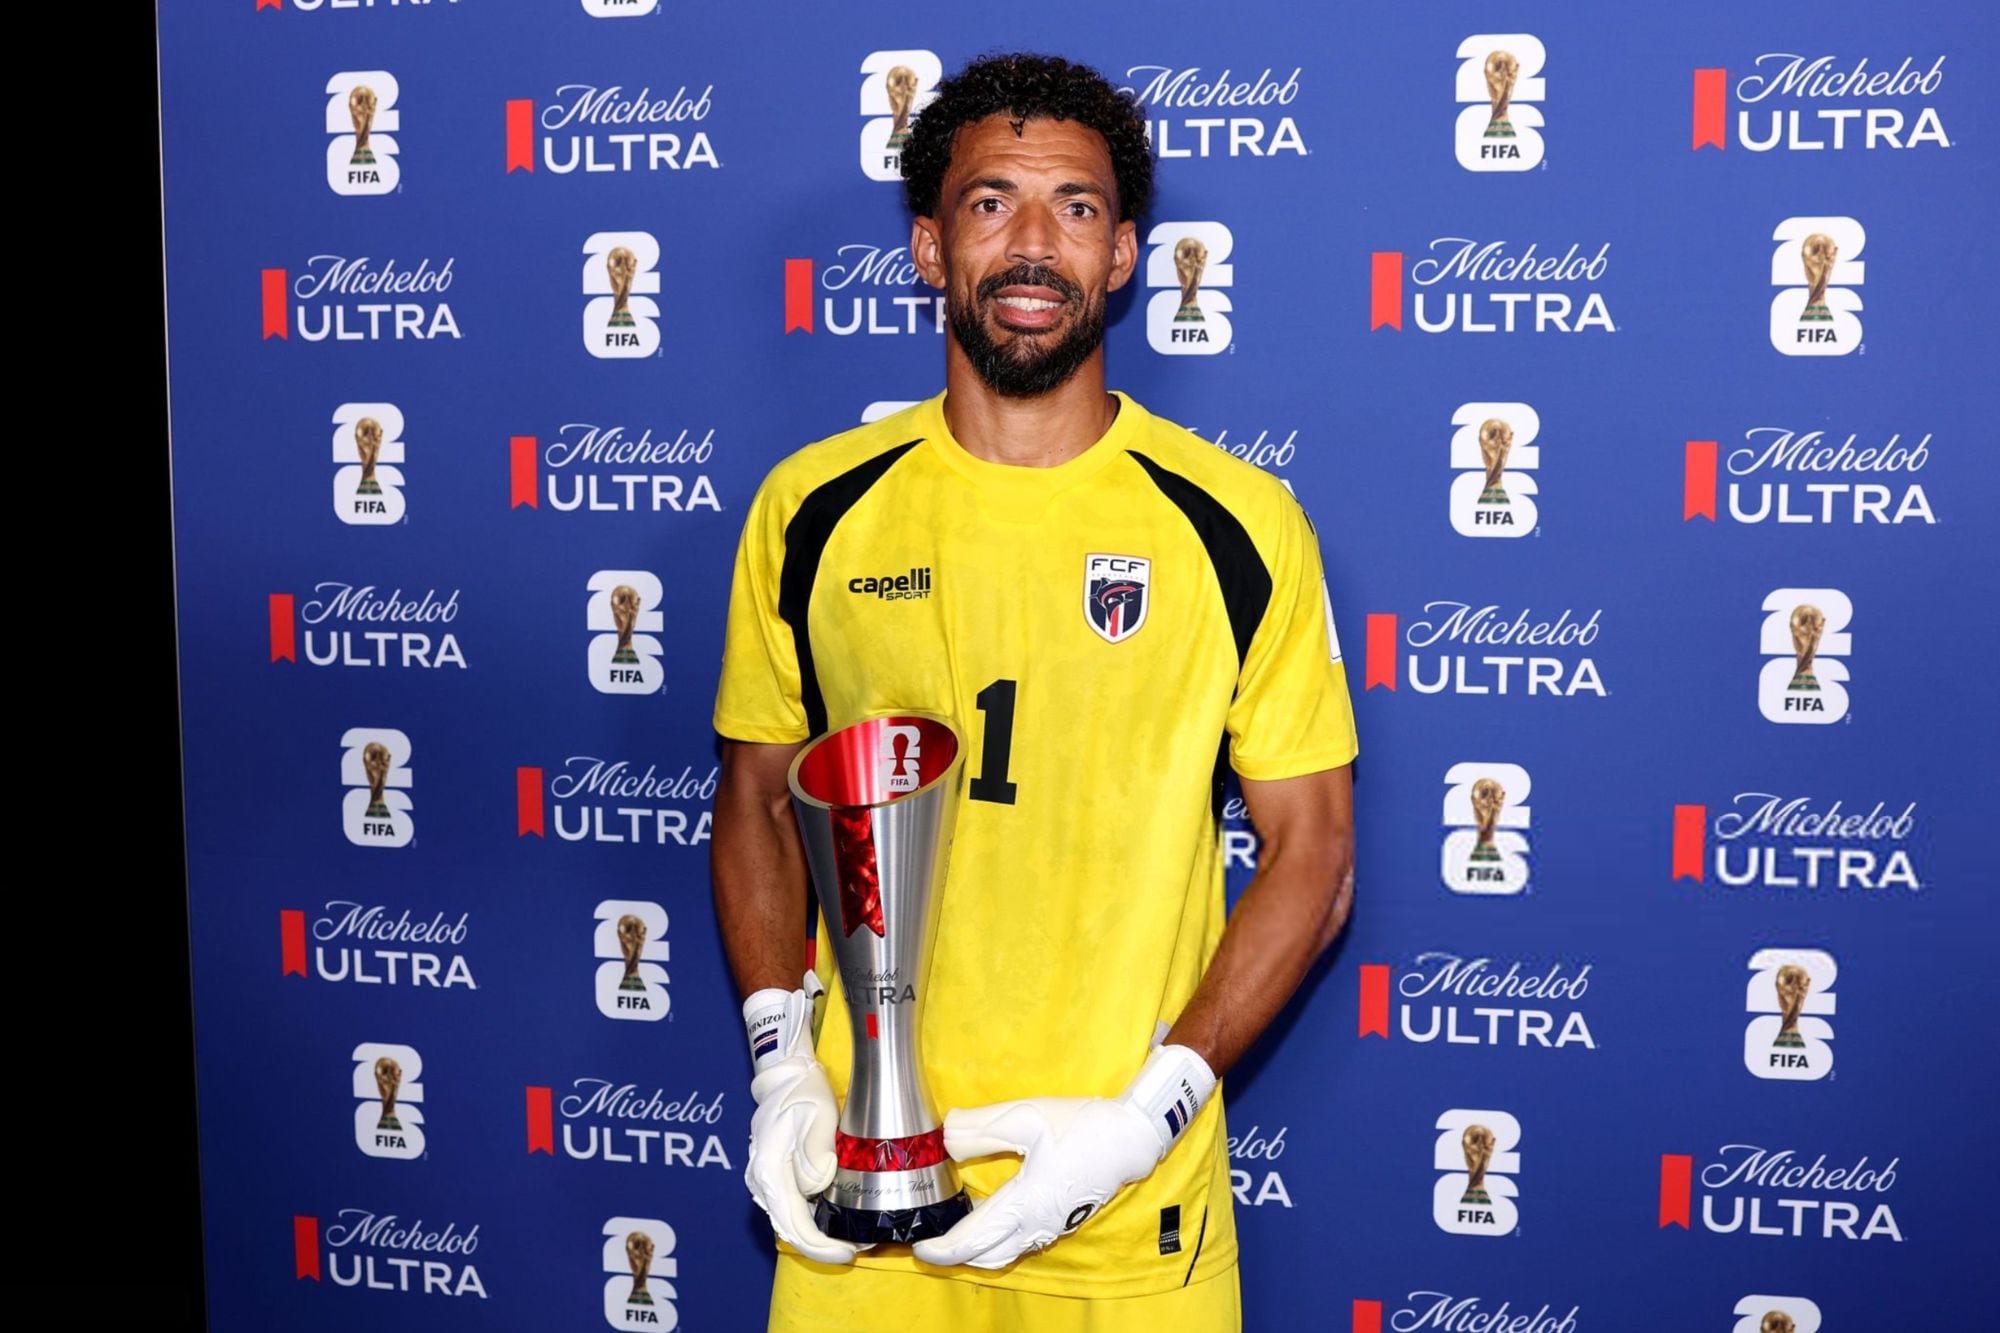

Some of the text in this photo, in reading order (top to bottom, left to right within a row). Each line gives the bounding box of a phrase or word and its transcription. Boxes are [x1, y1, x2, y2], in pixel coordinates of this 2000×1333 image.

[1117, 66, 1301, 107] Michelob
[1737, 54, 1945, 102] Michelob
[542, 85, 713, 129] Michelob
[1144, 117, 1308, 158] LTRA
[1739, 108, 1950, 151] ULTRA
[544, 133, 719, 173] ULTRA
[883, 155, 899, 169] FI
[1480, 144, 1521, 159] FIFA
[348, 170, 381, 184] FIFA
[295, 255, 454, 298] Michelob
[1413, 238, 1610, 285] Michelob
[298, 304, 461, 341] ULTRA
[825, 297, 946, 335] ULT
[1415, 293, 1615, 332] ULTRA
[605, 333, 640, 347] FIFA
[1171, 328, 1210, 343] FIFA
[1796, 328, 1838, 343] FIFA
[546, 424, 714, 467] Michelob
[1727, 428, 1931, 475] Michelob
[354, 500, 387, 514] FIFA
[548, 475, 721, 511] ULTRA
[1729, 484, 1936, 523] ULTRA
[1474, 510, 1515, 526] FIFA
[848, 567, 931, 599] capelli
[1092, 558, 1145, 573] FCF
[303, 582, 459, 623] Michelob
[886, 591, 931, 601] SPORT
[1407, 601, 1601, 647] Michelob
[305, 631, 467, 668] ULTRA
[609, 669, 645, 684] FIFA
[1409, 655, 1606, 696] ULTRA
[1784, 697, 1825, 712] FIFA
[969, 679, 1017, 806] 1
[552, 757, 718, 799] Michelob
[890, 778, 910, 787] FIFA
[363, 822, 396, 837] FIFA
[1716, 793, 1915, 838] Michelob
[1466, 866, 1505, 882] FIFA
[1716, 846, 1919, 889] ULTRA
[314, 901, 468, 944] Michelob
[316, 947, 476, 989] ULTRA
[1399, 953, 1591, 999] Michelob
[617, 995, 651, 1011] FIFA
[1401, 1005, 1595, 1048] ULTRA
[1769, 1053, 1809, 1069] FIFA
[561, 1078, 724, 1124] Michelob
[375, 1134, 407, 1149] FIFA
[563, 1124, 731, 1170] ULTRA
[1702, 1145, 1899, 1192] Michelob
[327, 1209, 479, 1254] Michelob
[1457, 1209, 1496, 1225] FIFA
[1703, 1195, 1902, 1241] ULTRA
[330, 1253, 487, 1298] ULTRA
[625, 1309, 659, 1324] FIFA
[1391, 1291, 1580, 1333] Michelob
